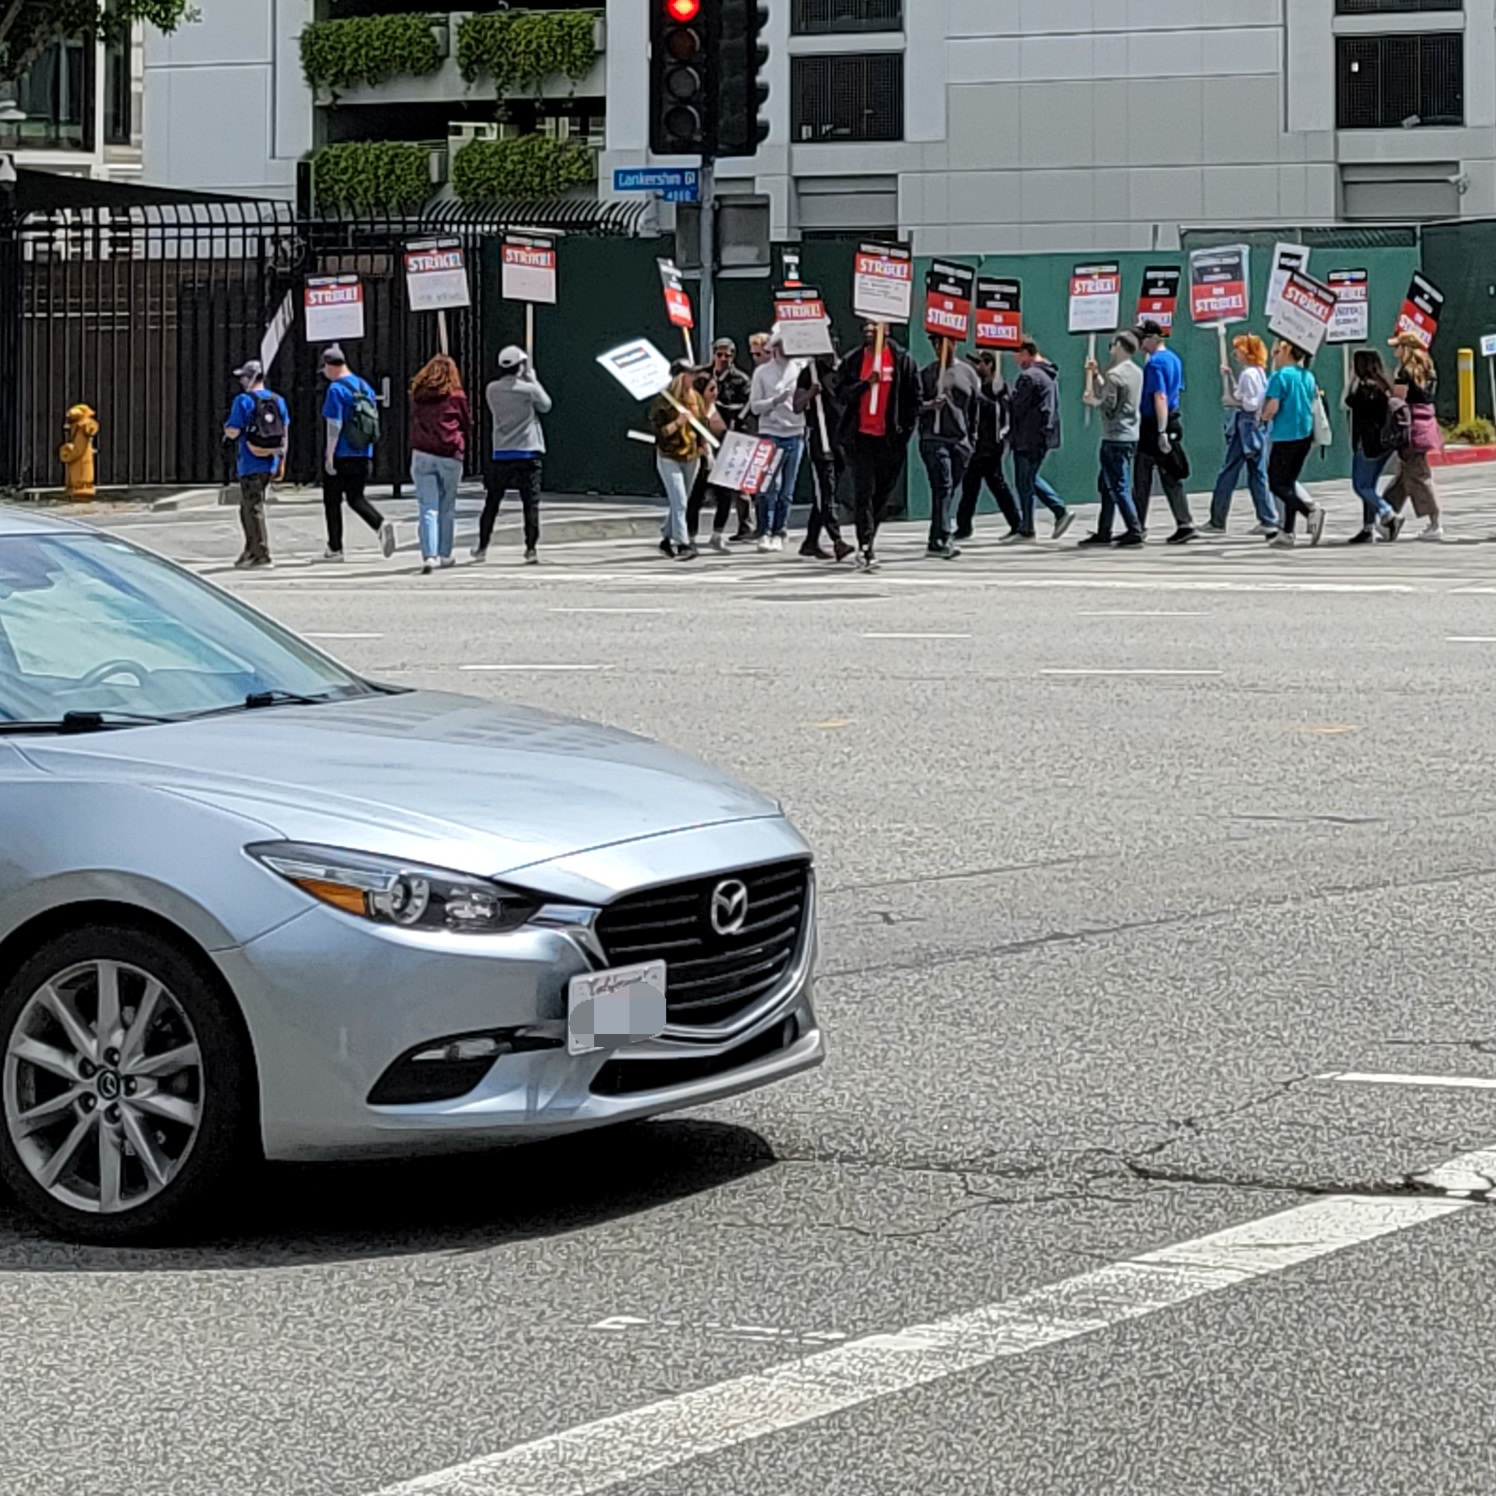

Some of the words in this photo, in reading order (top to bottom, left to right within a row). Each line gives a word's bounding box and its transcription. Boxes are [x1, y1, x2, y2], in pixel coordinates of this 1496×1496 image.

[408, 252, 462, 272] STRIKE!
[506, 248, 552, 267] STRIKE!
[860, 257, 909, 278] STRIKE!
[309, 286, 358, 305] STRIKE!
[1074, 278, 1116, 295] STRIKE!
[1285, 285, 1329, 322] STRIKE!
[927, 308, 967, 332] STRIKE!
